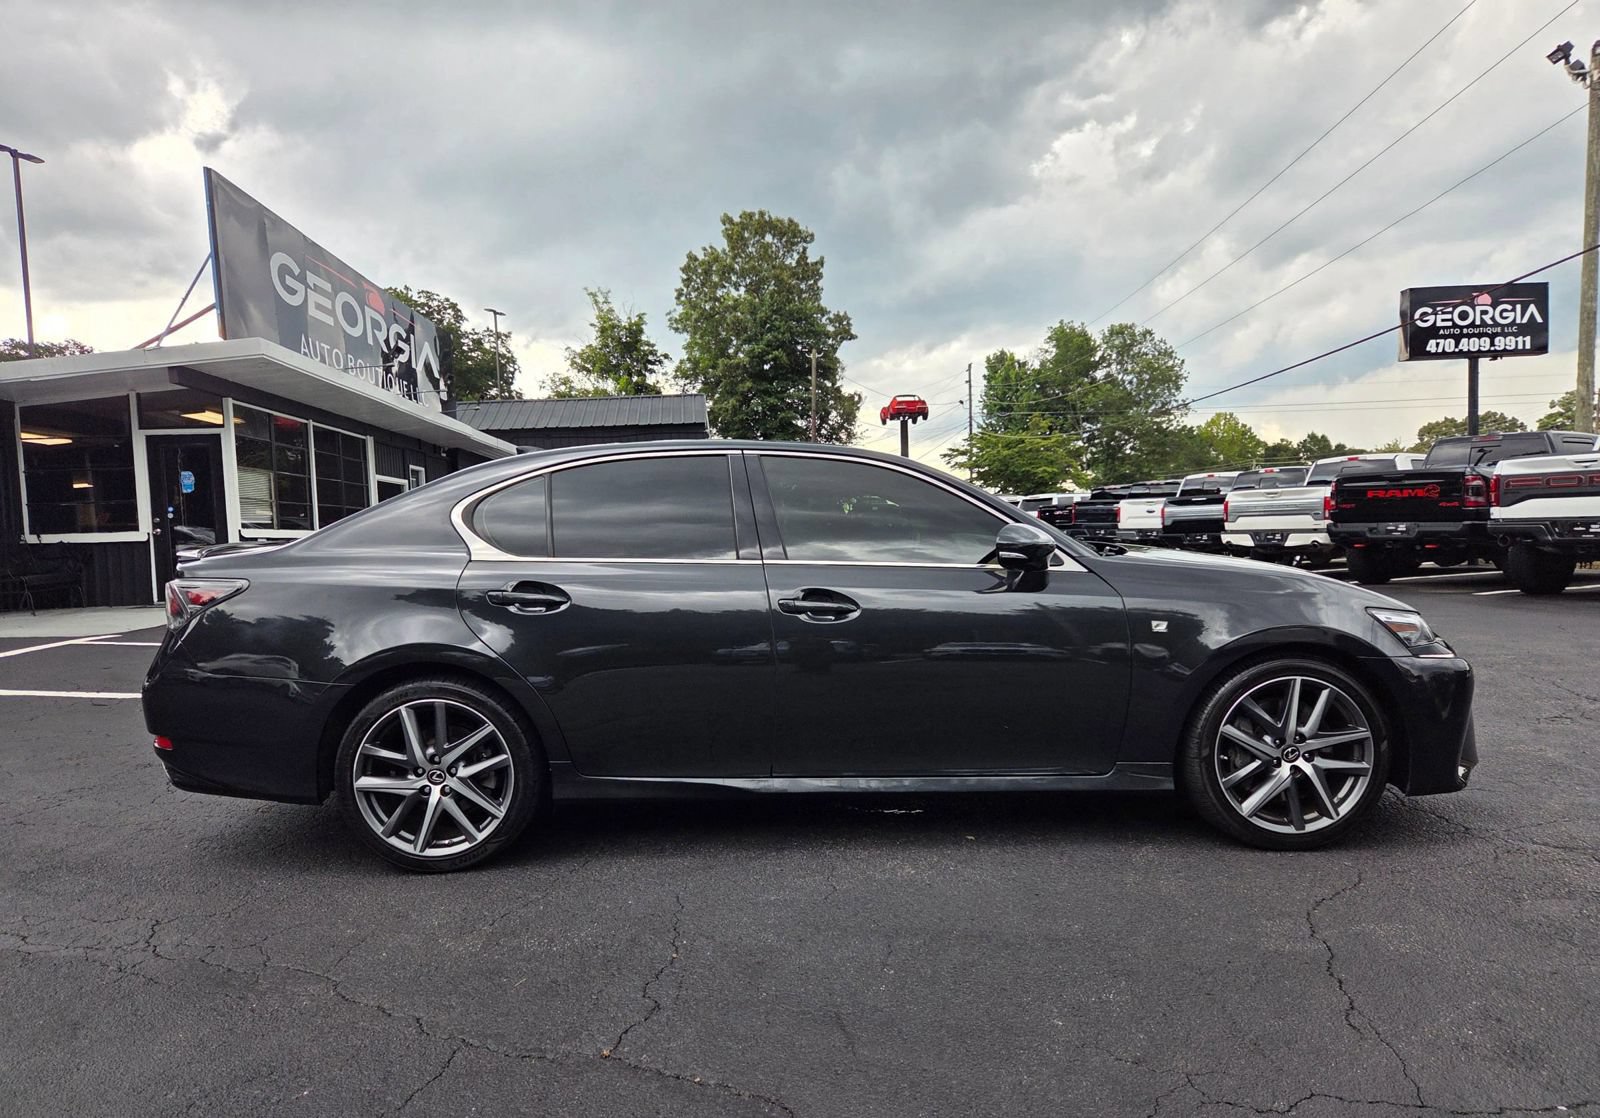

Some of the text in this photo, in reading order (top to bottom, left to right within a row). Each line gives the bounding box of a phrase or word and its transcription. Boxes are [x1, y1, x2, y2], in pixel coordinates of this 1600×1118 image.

[270, 251, 440, 378] GEORGIA
[1414, 304, 1543, 327] GEORGIA
[300, 333, 344, 370] AUTO
[1426, 336, 1531, 353] 470.409.9911
[1366, 488, 1426, 498] RAM
